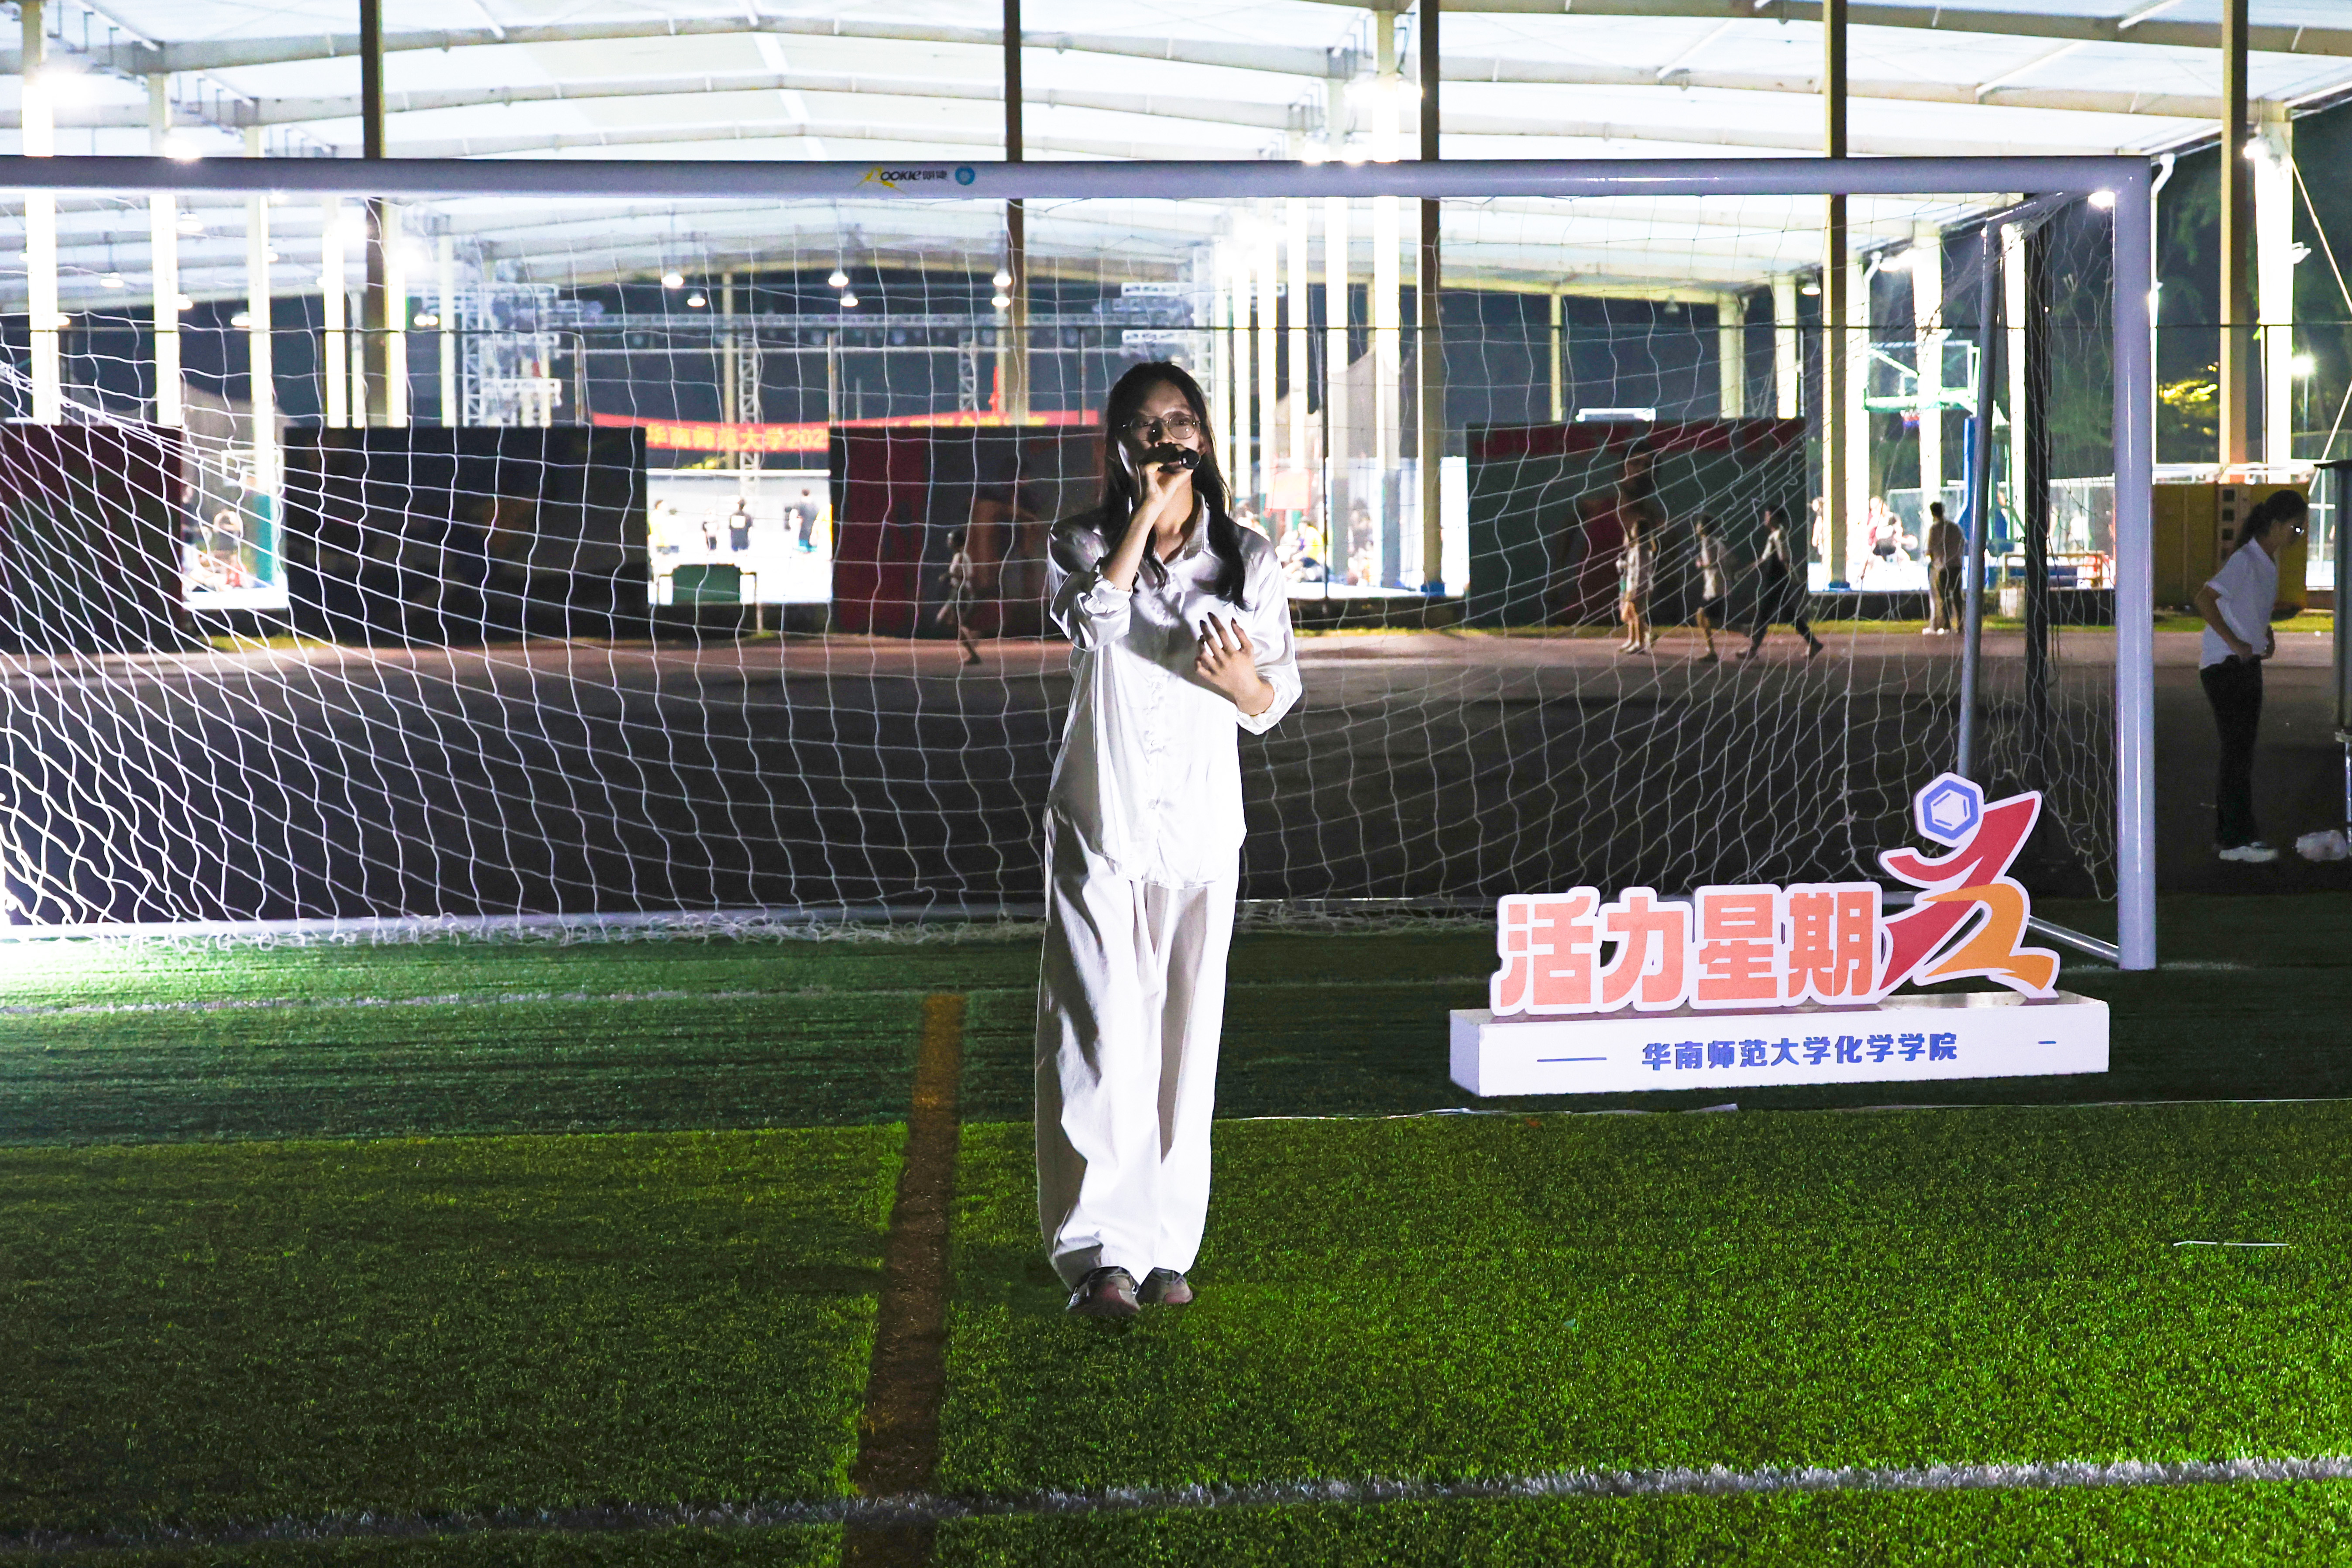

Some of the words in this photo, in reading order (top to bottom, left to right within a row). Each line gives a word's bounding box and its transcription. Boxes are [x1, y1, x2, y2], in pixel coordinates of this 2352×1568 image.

[646, 423, 828, 449] 华南师范大学202
[1642, 1033, 1957, 1070] 华南师范大学化学学院
